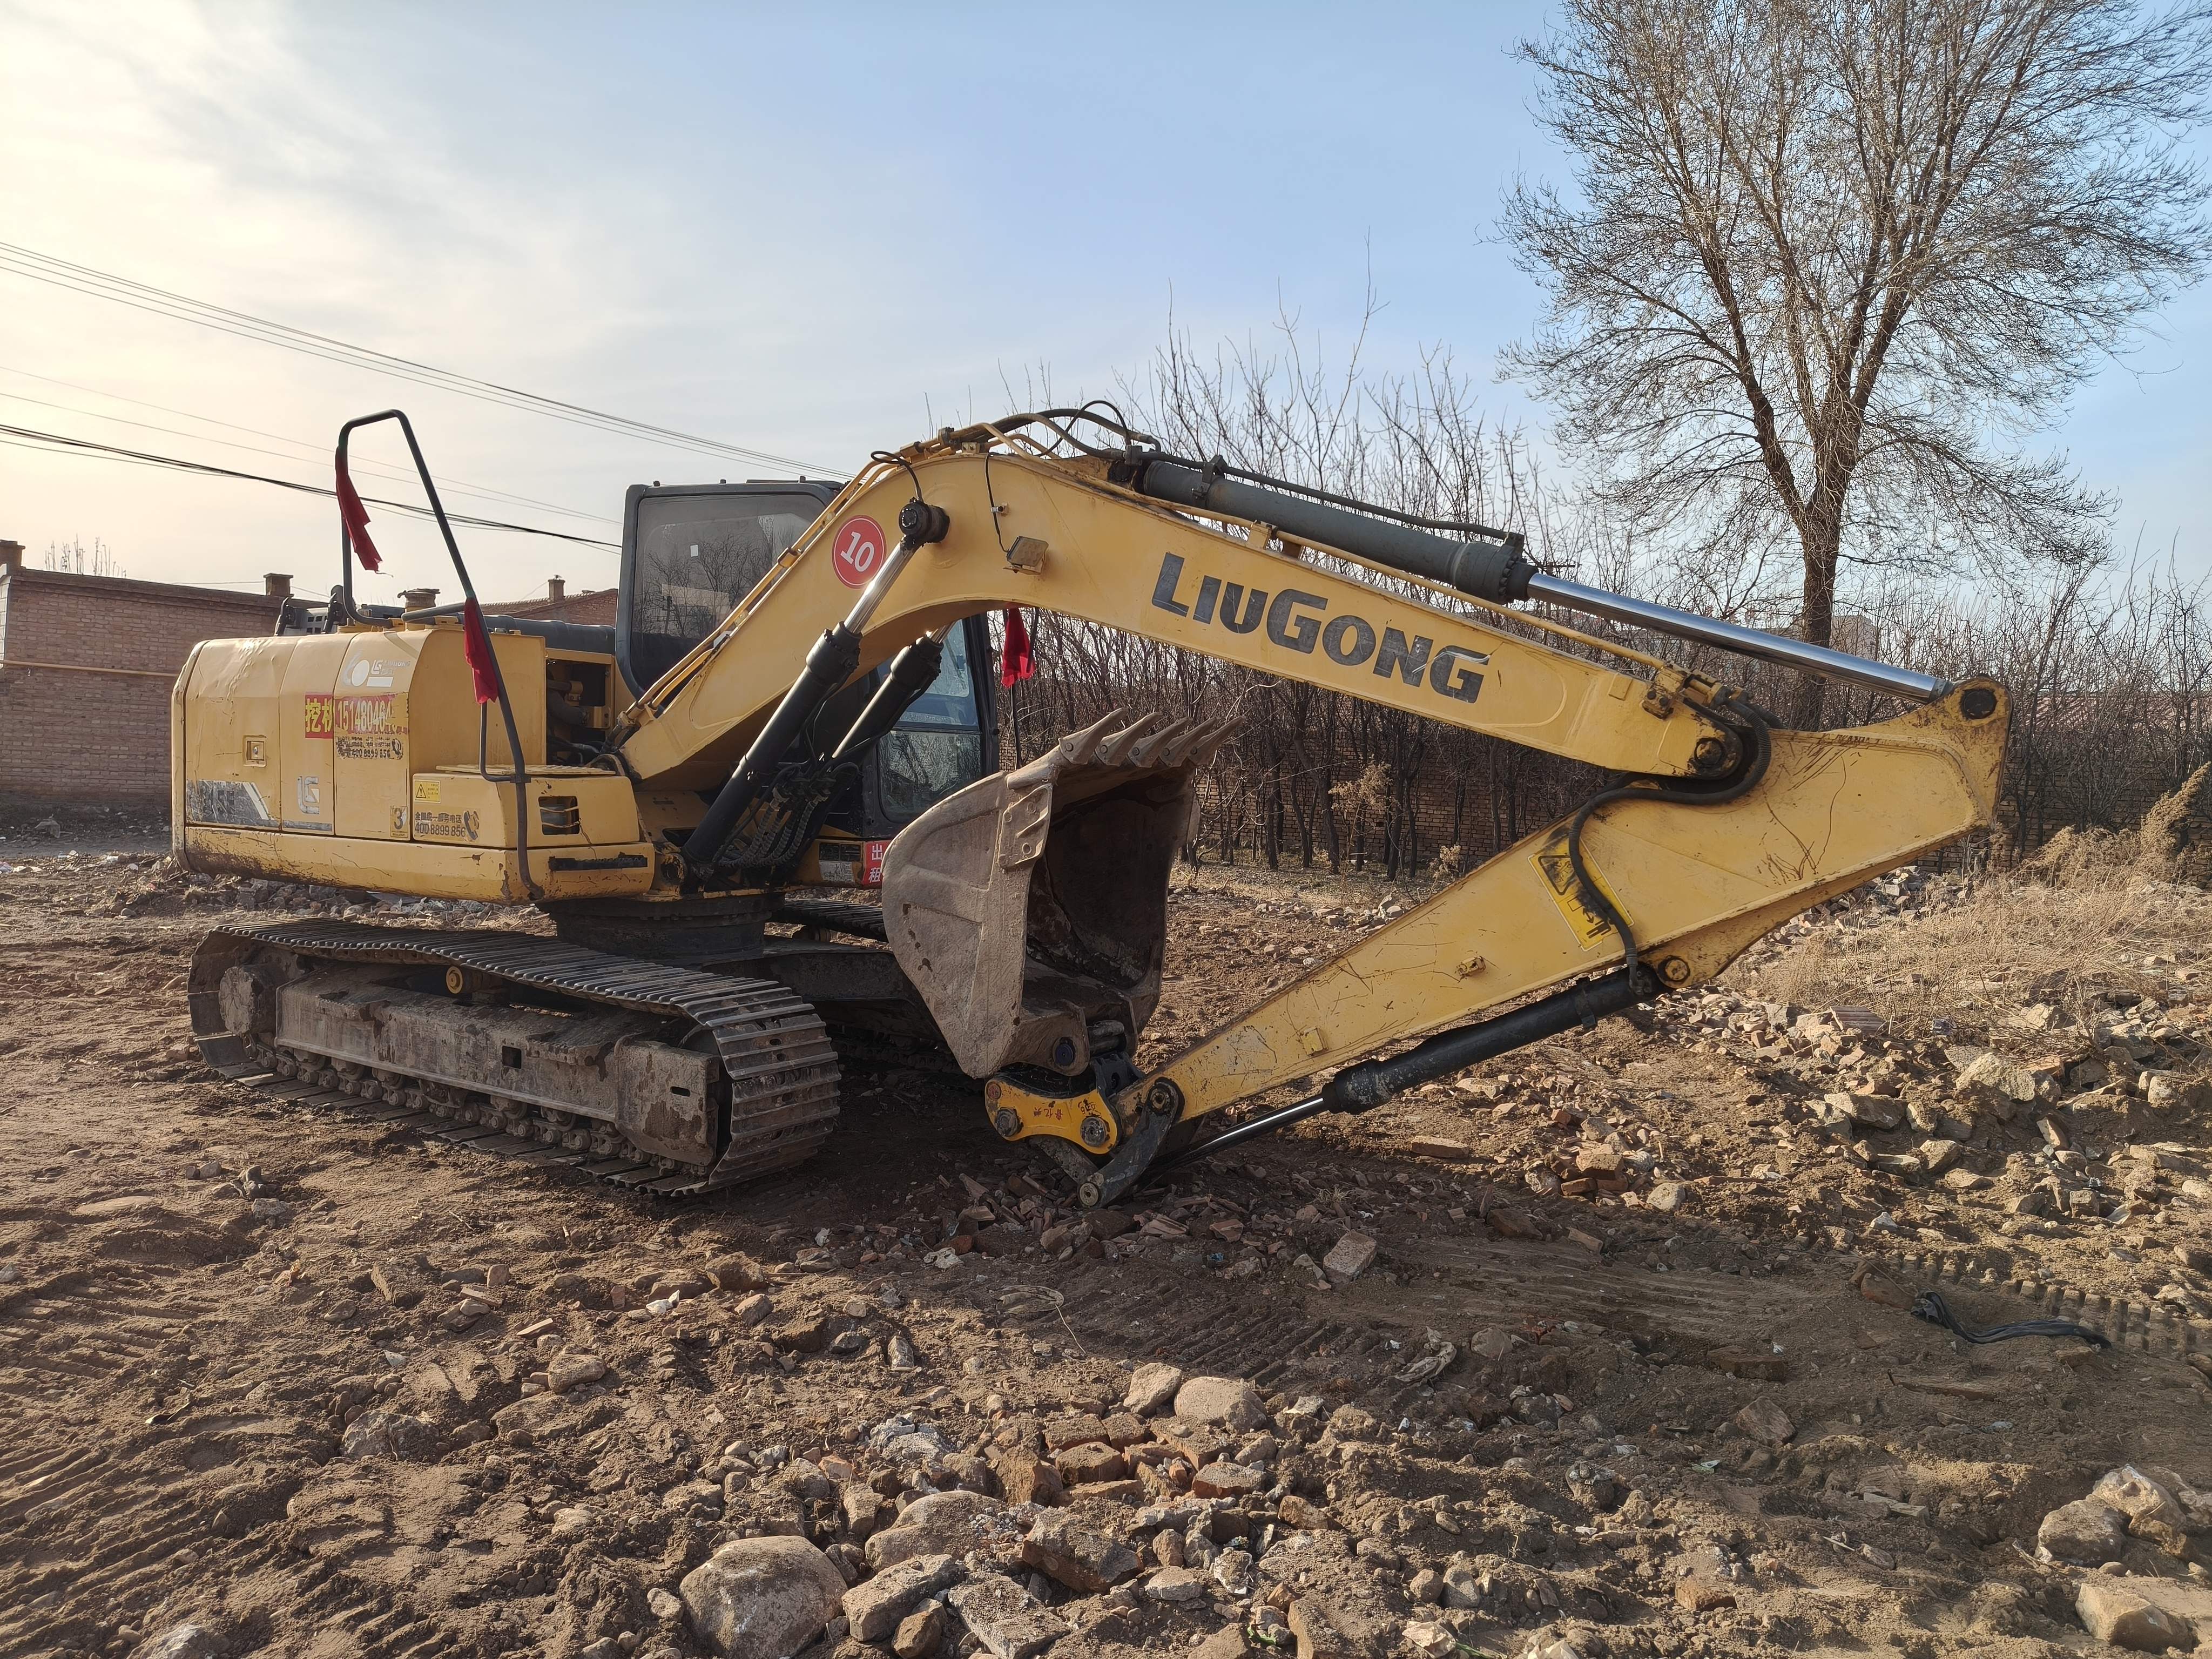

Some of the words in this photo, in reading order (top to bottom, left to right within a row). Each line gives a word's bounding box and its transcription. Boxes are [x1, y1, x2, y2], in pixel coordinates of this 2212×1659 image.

[840, 531, 874, 572] 10
[363, 749, 378, 758] 8899
[414, 822, 429, 834] 400
[430, 824, 449, 836] 8899
[451, 826, 466, 838] 856
[868, 844, 882, 883] 出租
